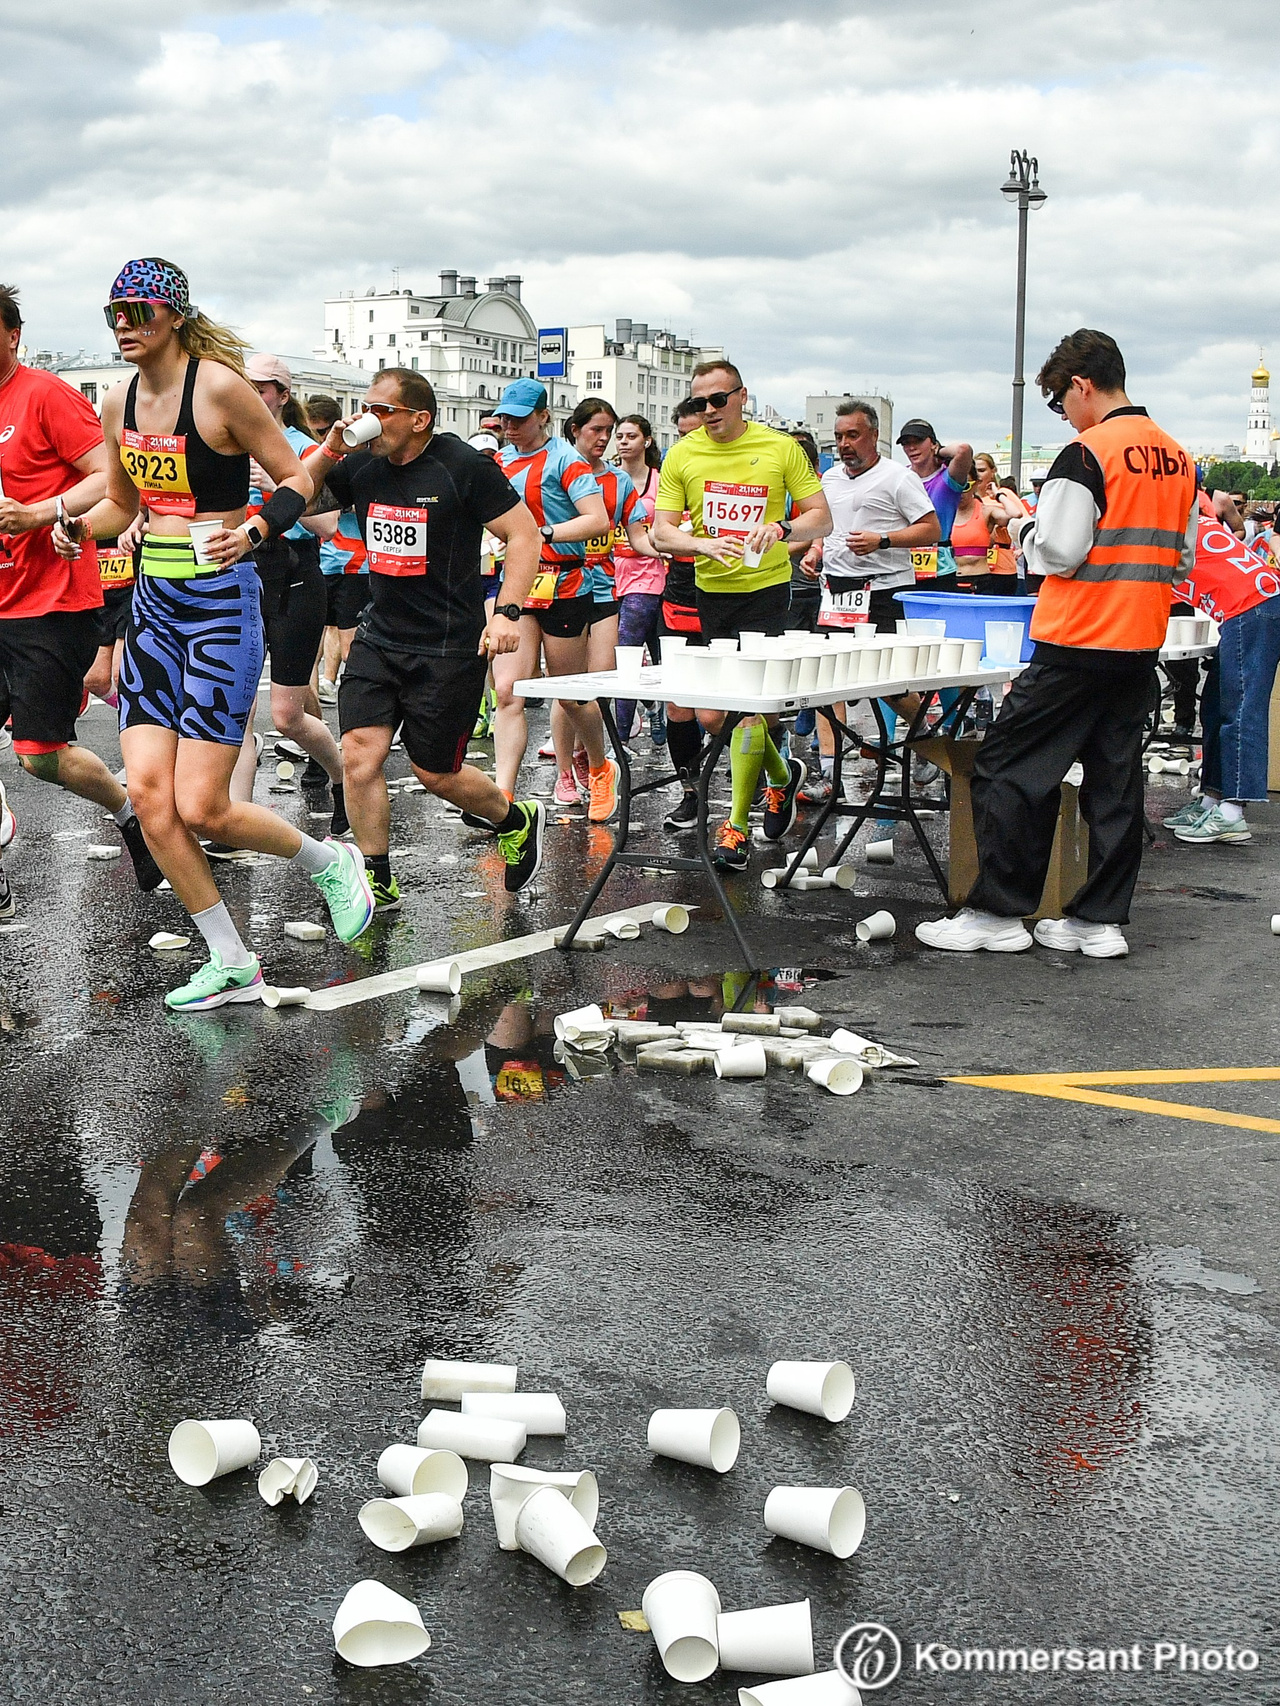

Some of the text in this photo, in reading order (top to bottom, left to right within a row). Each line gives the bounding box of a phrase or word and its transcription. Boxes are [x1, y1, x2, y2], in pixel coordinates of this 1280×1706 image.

[126, 452, 178, 481] 3923
[1123, 445, 1189, 481] СУДЬЯ
[707, 501, 764, 523] 15697
[373, 521, 417, 546] 5388
[709, 526, 716, 535] G
[371, 552, 378, 564] G
[383, 545, 402, 553] СЕРГЕЙ
